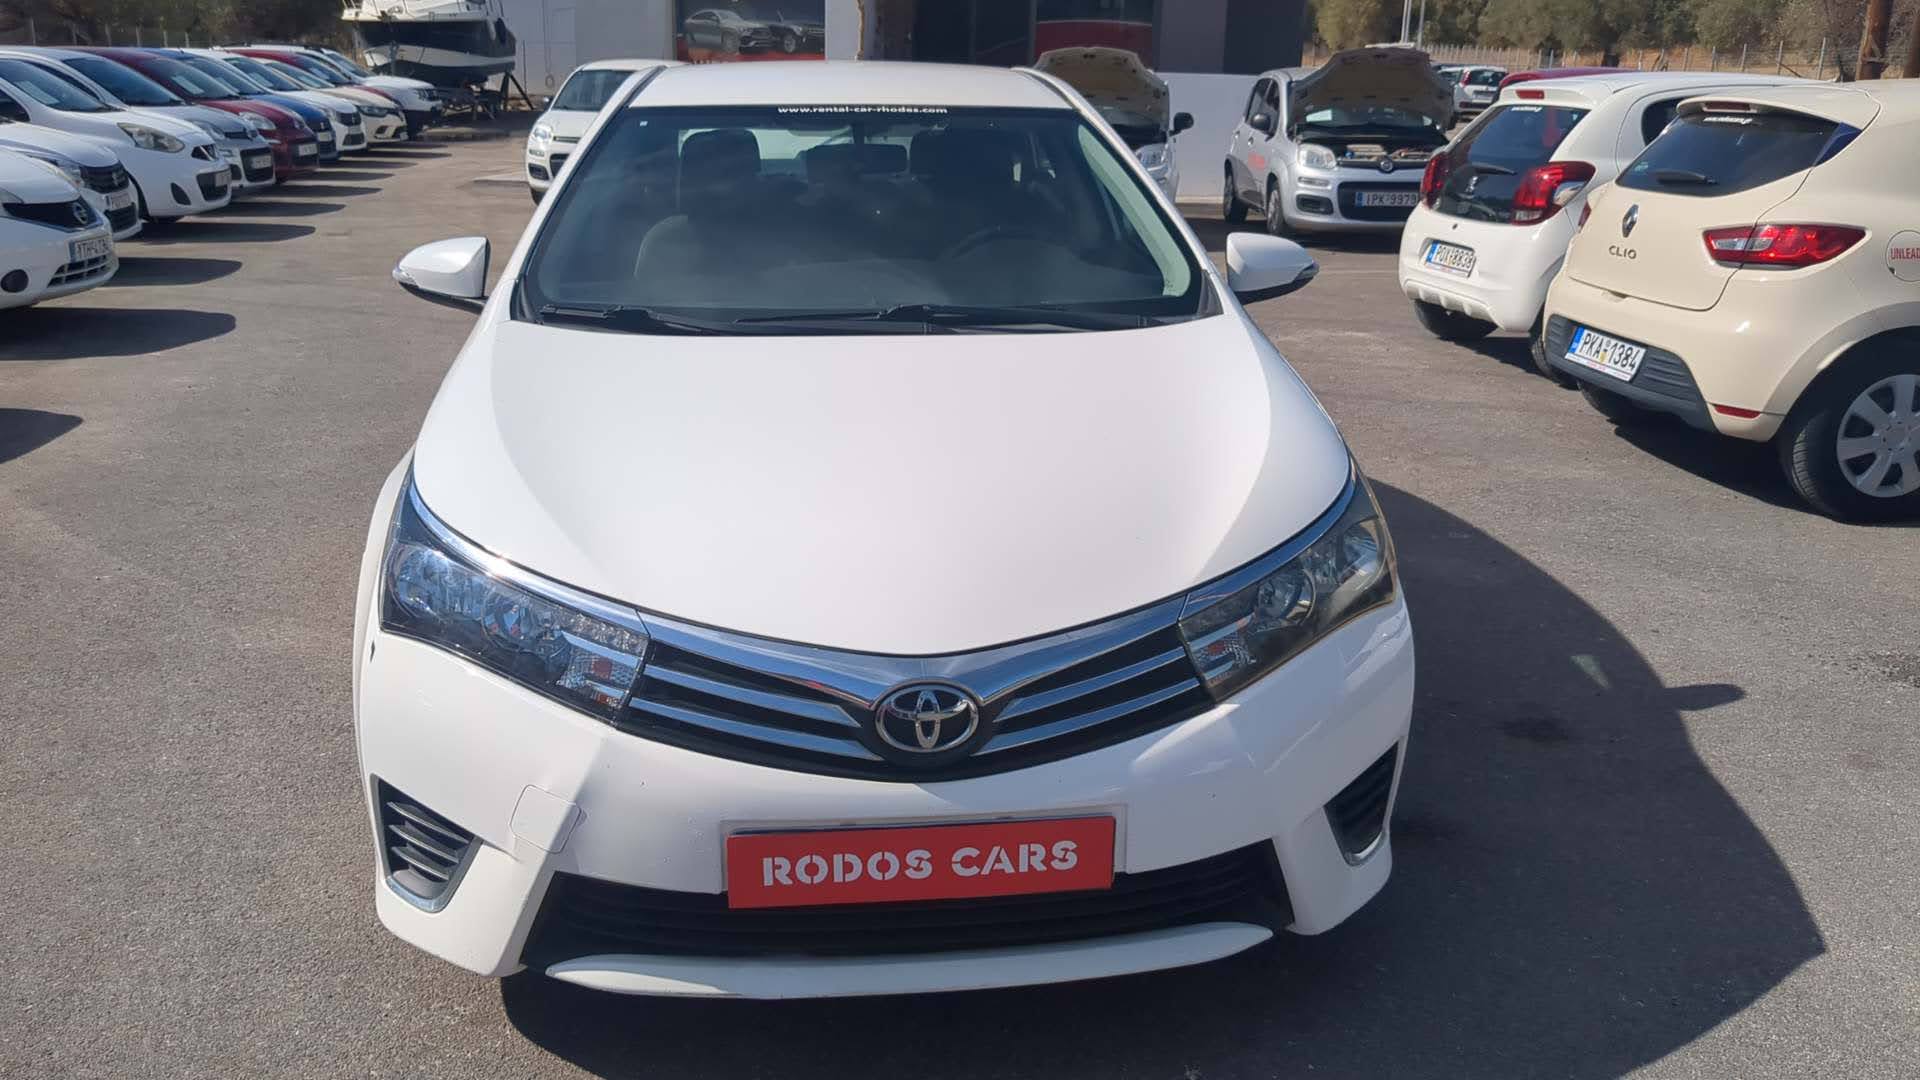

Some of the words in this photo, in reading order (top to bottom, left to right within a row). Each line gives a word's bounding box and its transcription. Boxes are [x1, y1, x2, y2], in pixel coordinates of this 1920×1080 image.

[778, 105, 948, 114] www.rental-car-rhodes.com
[1608, 245, 1637, 260] CLIO
[1579, 332, 1640, 371] PKA-1384
[763, 849, 933, 886] RODOS
[951, 840, 1078, 877] CARS
